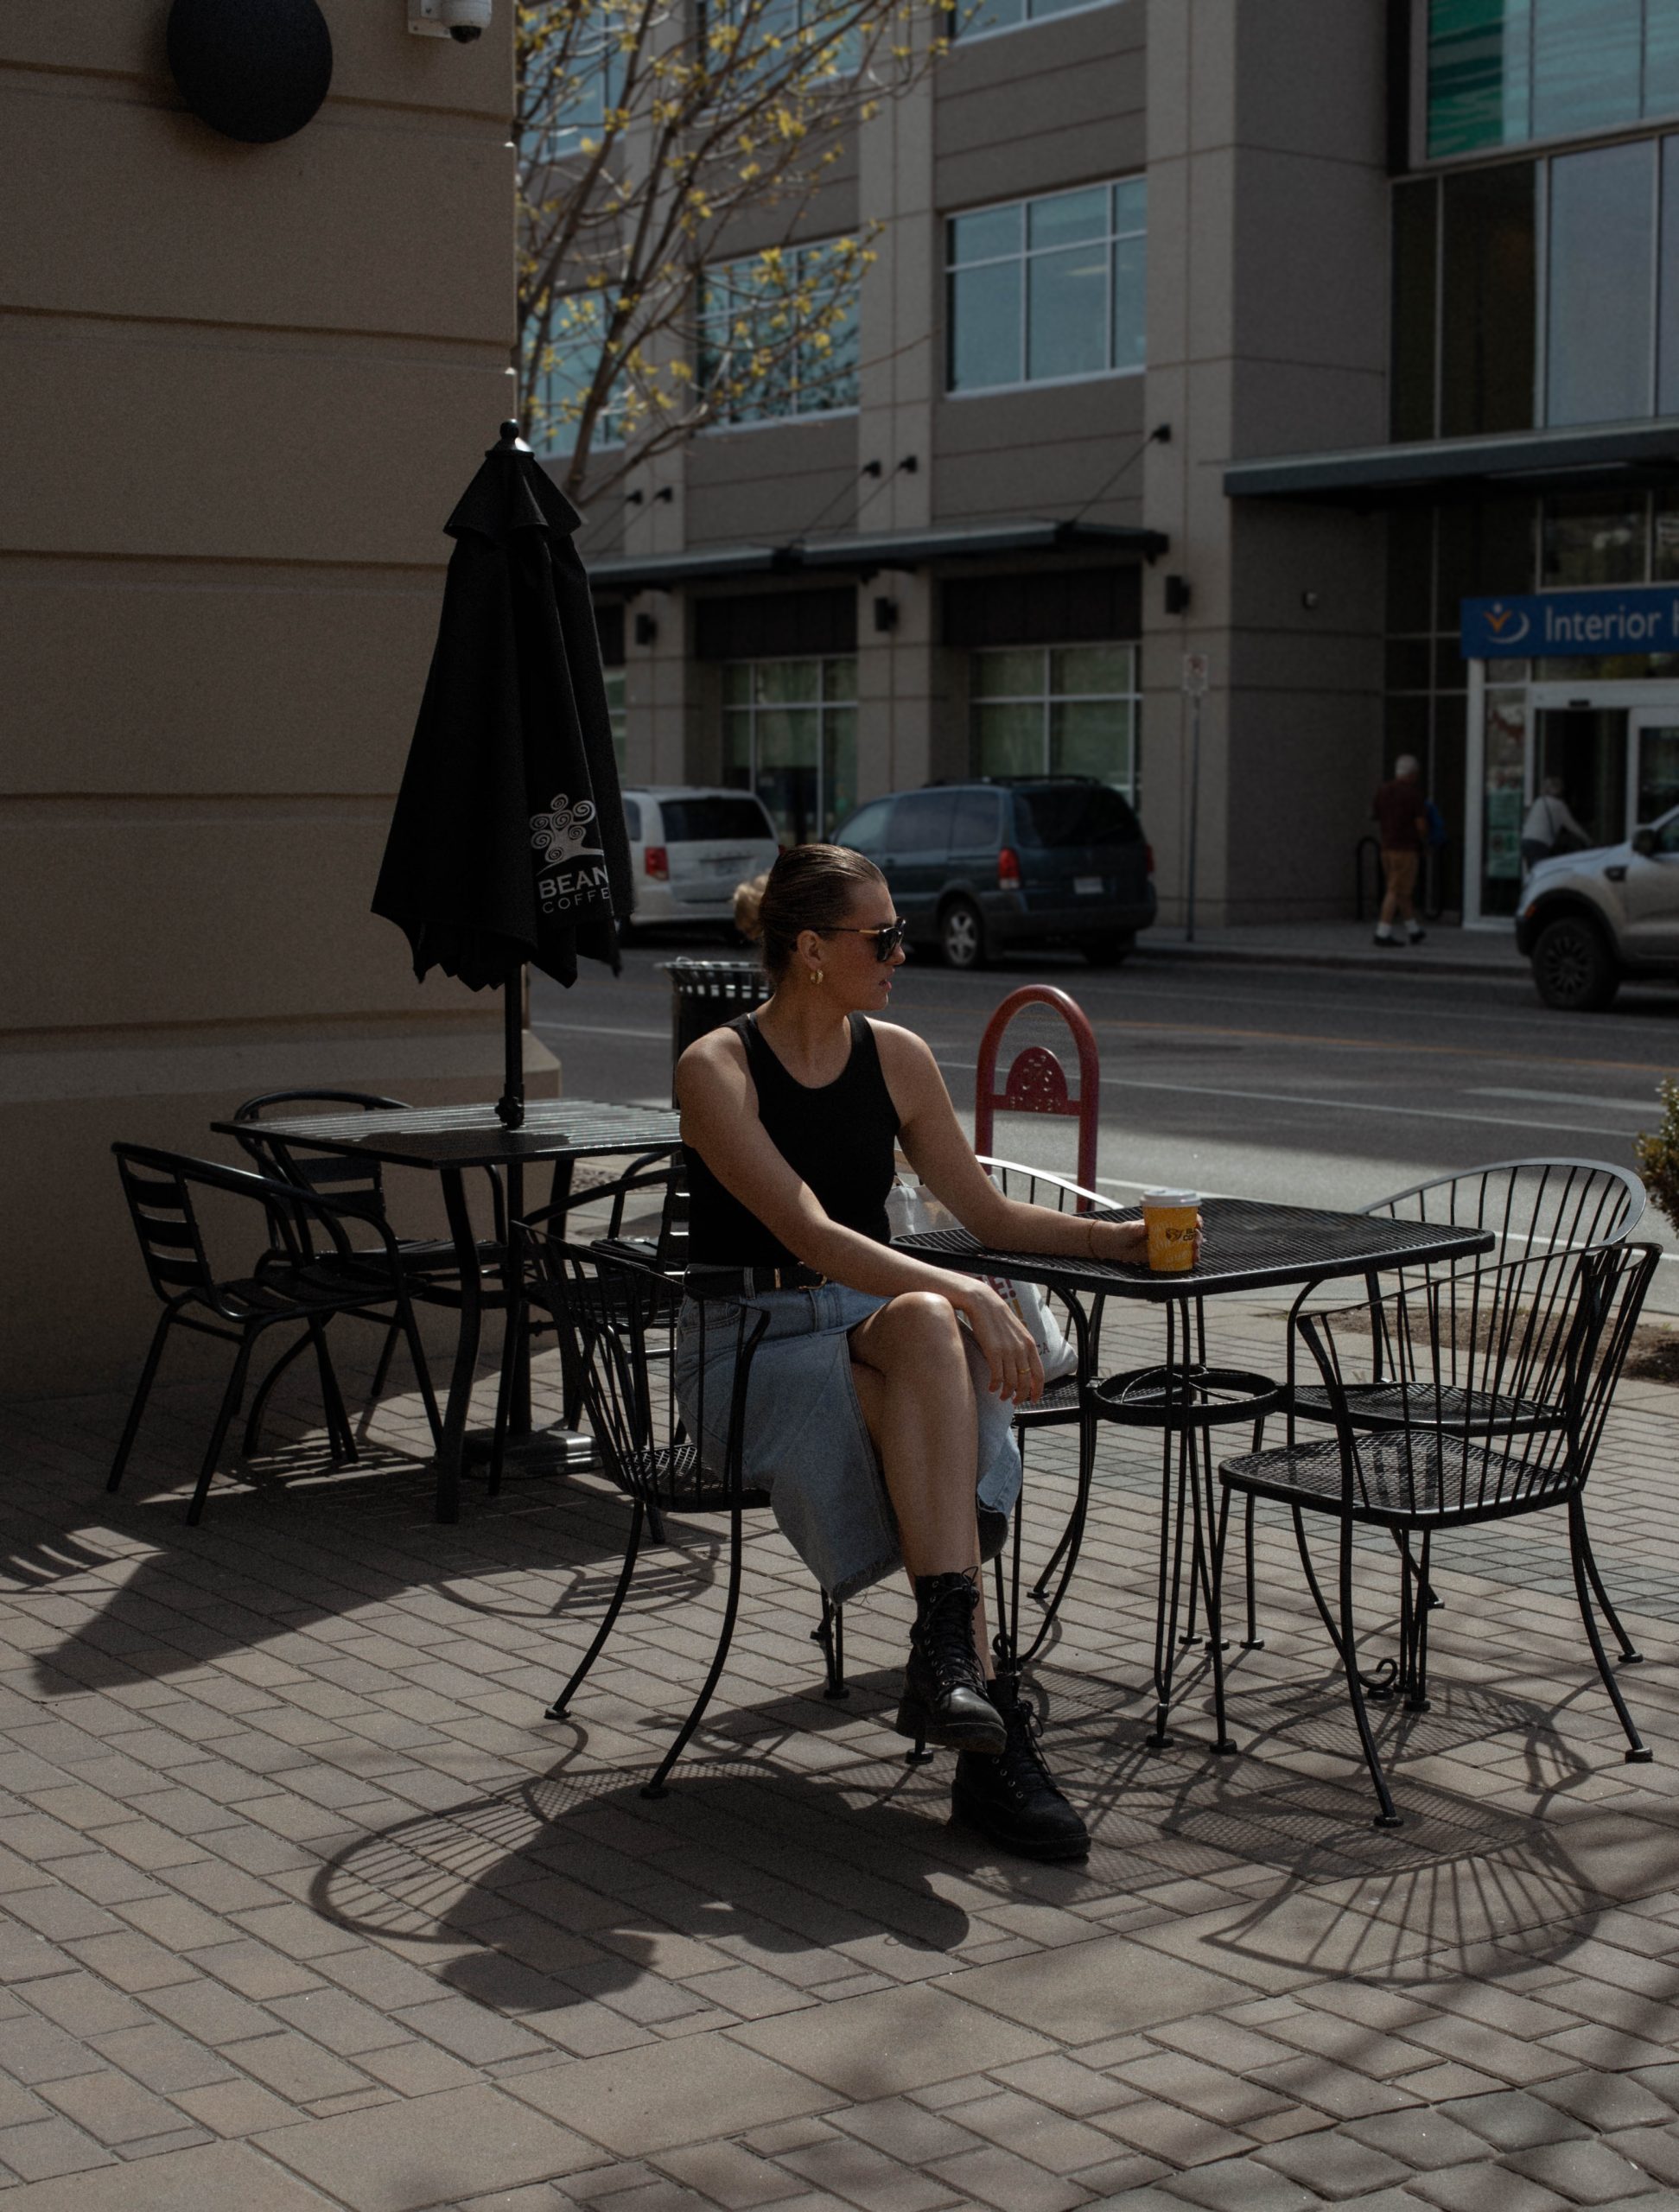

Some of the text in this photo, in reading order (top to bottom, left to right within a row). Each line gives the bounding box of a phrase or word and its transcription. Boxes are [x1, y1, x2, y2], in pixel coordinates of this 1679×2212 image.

[1545, 603, 1663, 643] Interior
[537, 866, 608, 899] BEAN
[542, 887, 611, 914] COFFE
